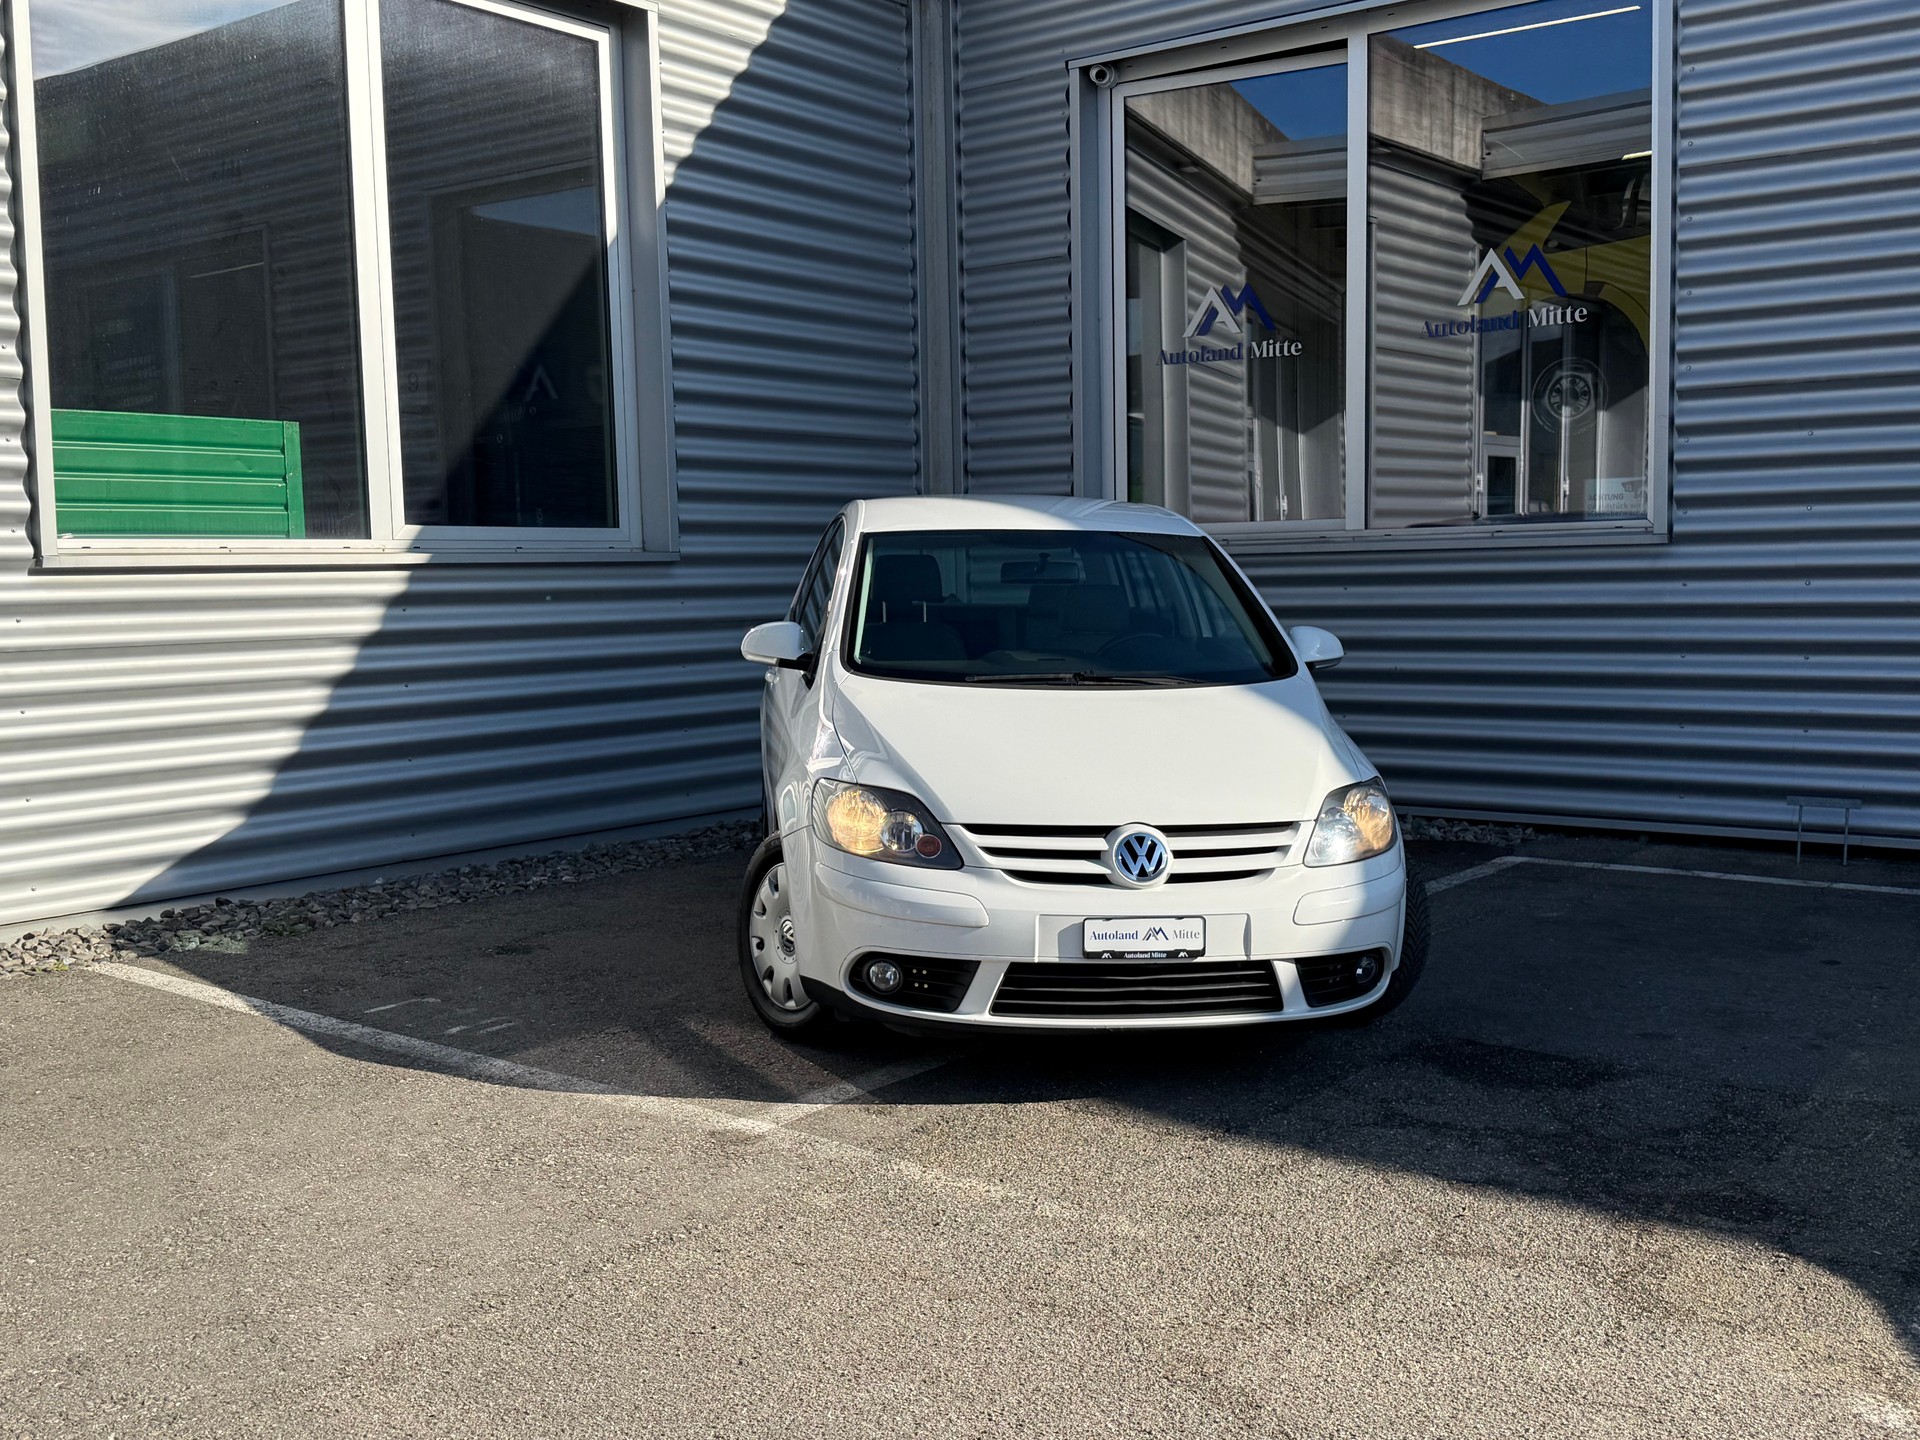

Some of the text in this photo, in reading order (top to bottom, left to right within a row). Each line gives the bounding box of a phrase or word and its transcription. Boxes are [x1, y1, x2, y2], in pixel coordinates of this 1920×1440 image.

[1421, 305, 1588, 338] Autoland Mitte
[1156, 338, 1303, 366] Autoland Mitte
[1089, 930, 1139, 941] Autoland
[1172, 928, 1201, 940] Mitte
[1123, 951, 1151, 959] Autoland
